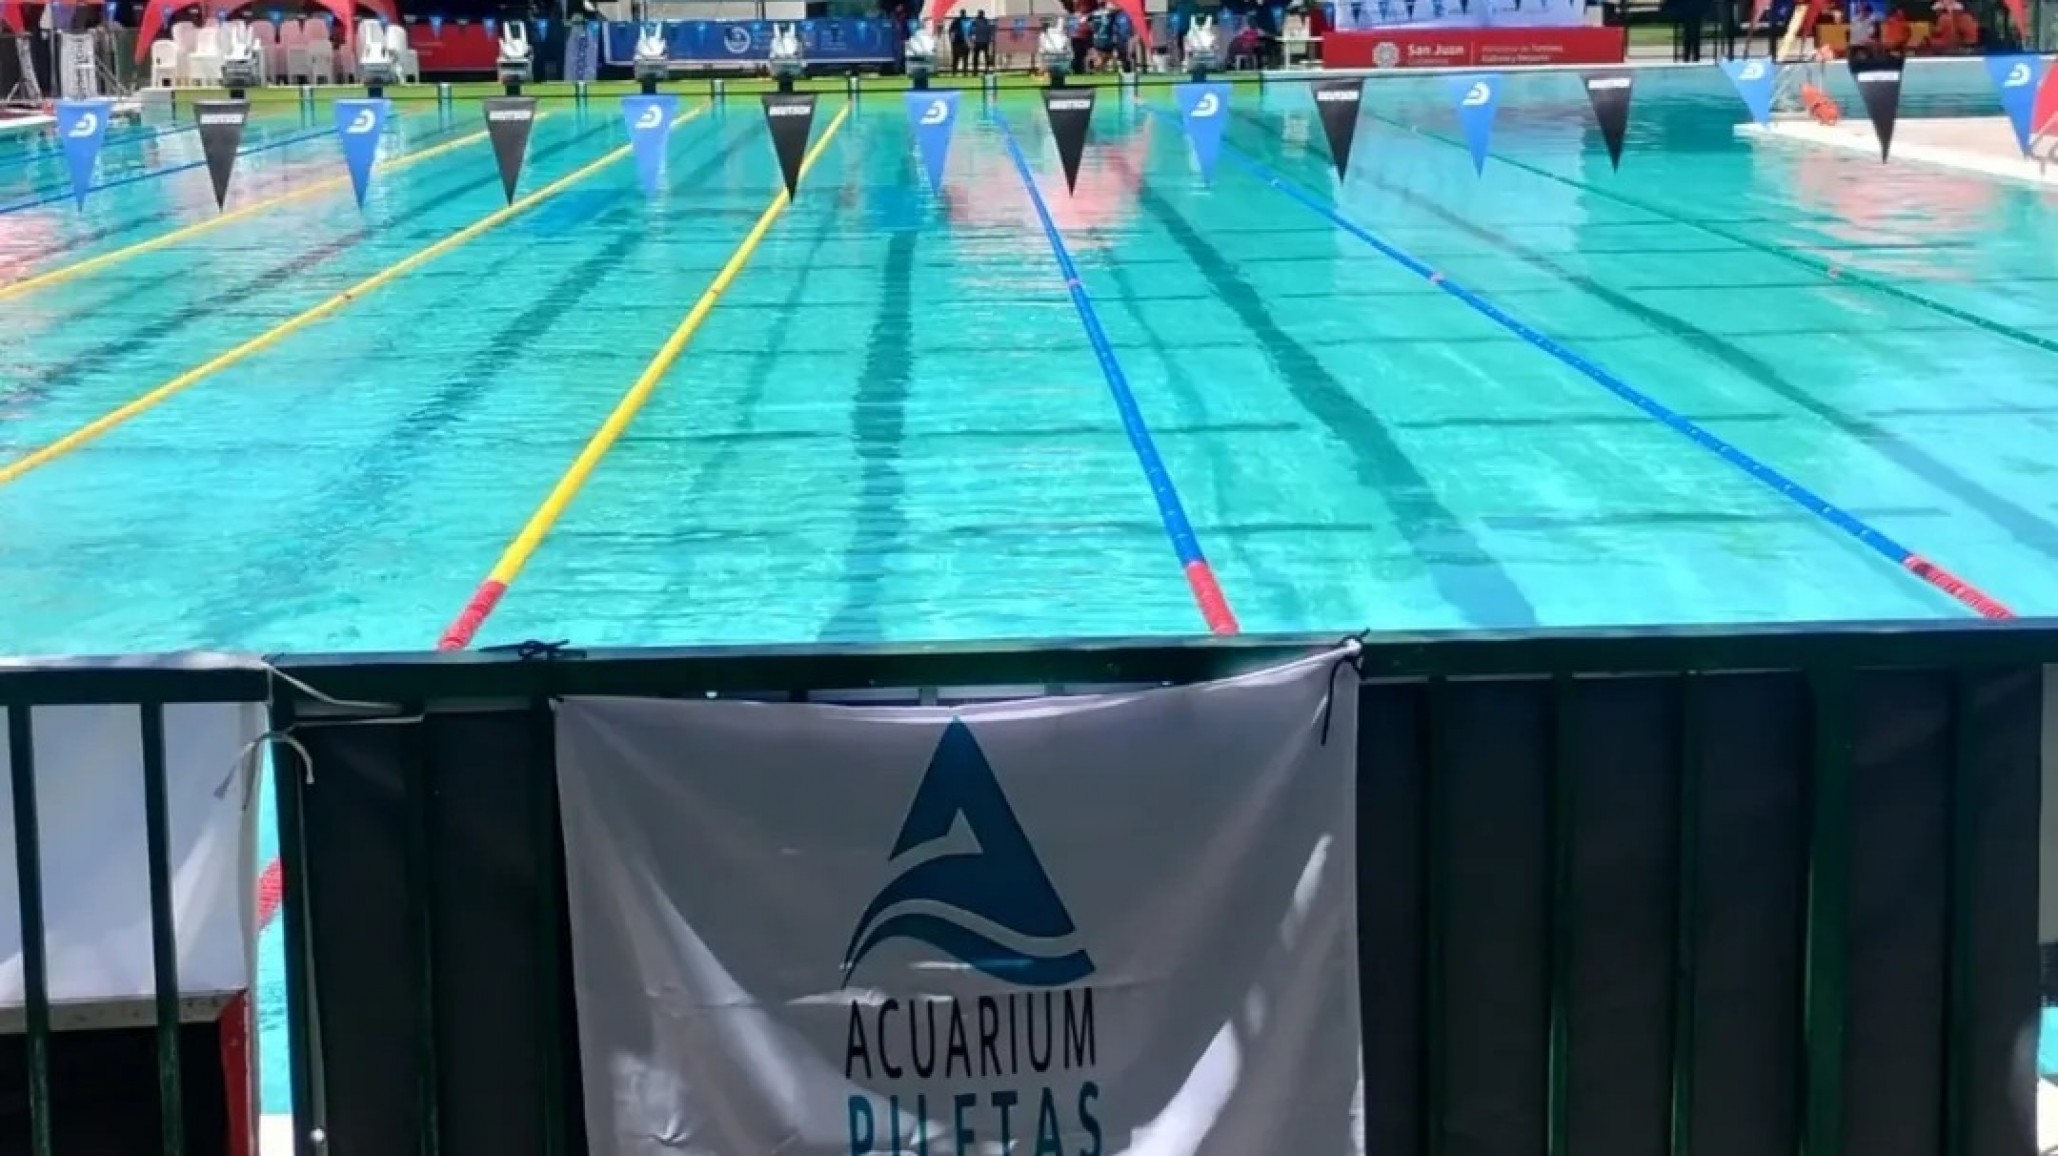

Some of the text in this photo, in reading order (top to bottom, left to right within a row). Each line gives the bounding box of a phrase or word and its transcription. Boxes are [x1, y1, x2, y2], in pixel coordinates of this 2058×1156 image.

[1407, 43, 1431, 56] San
[1434, 42, 1465, 56] Juan
[845, 987, 1096, 1080] ACUARIUM
